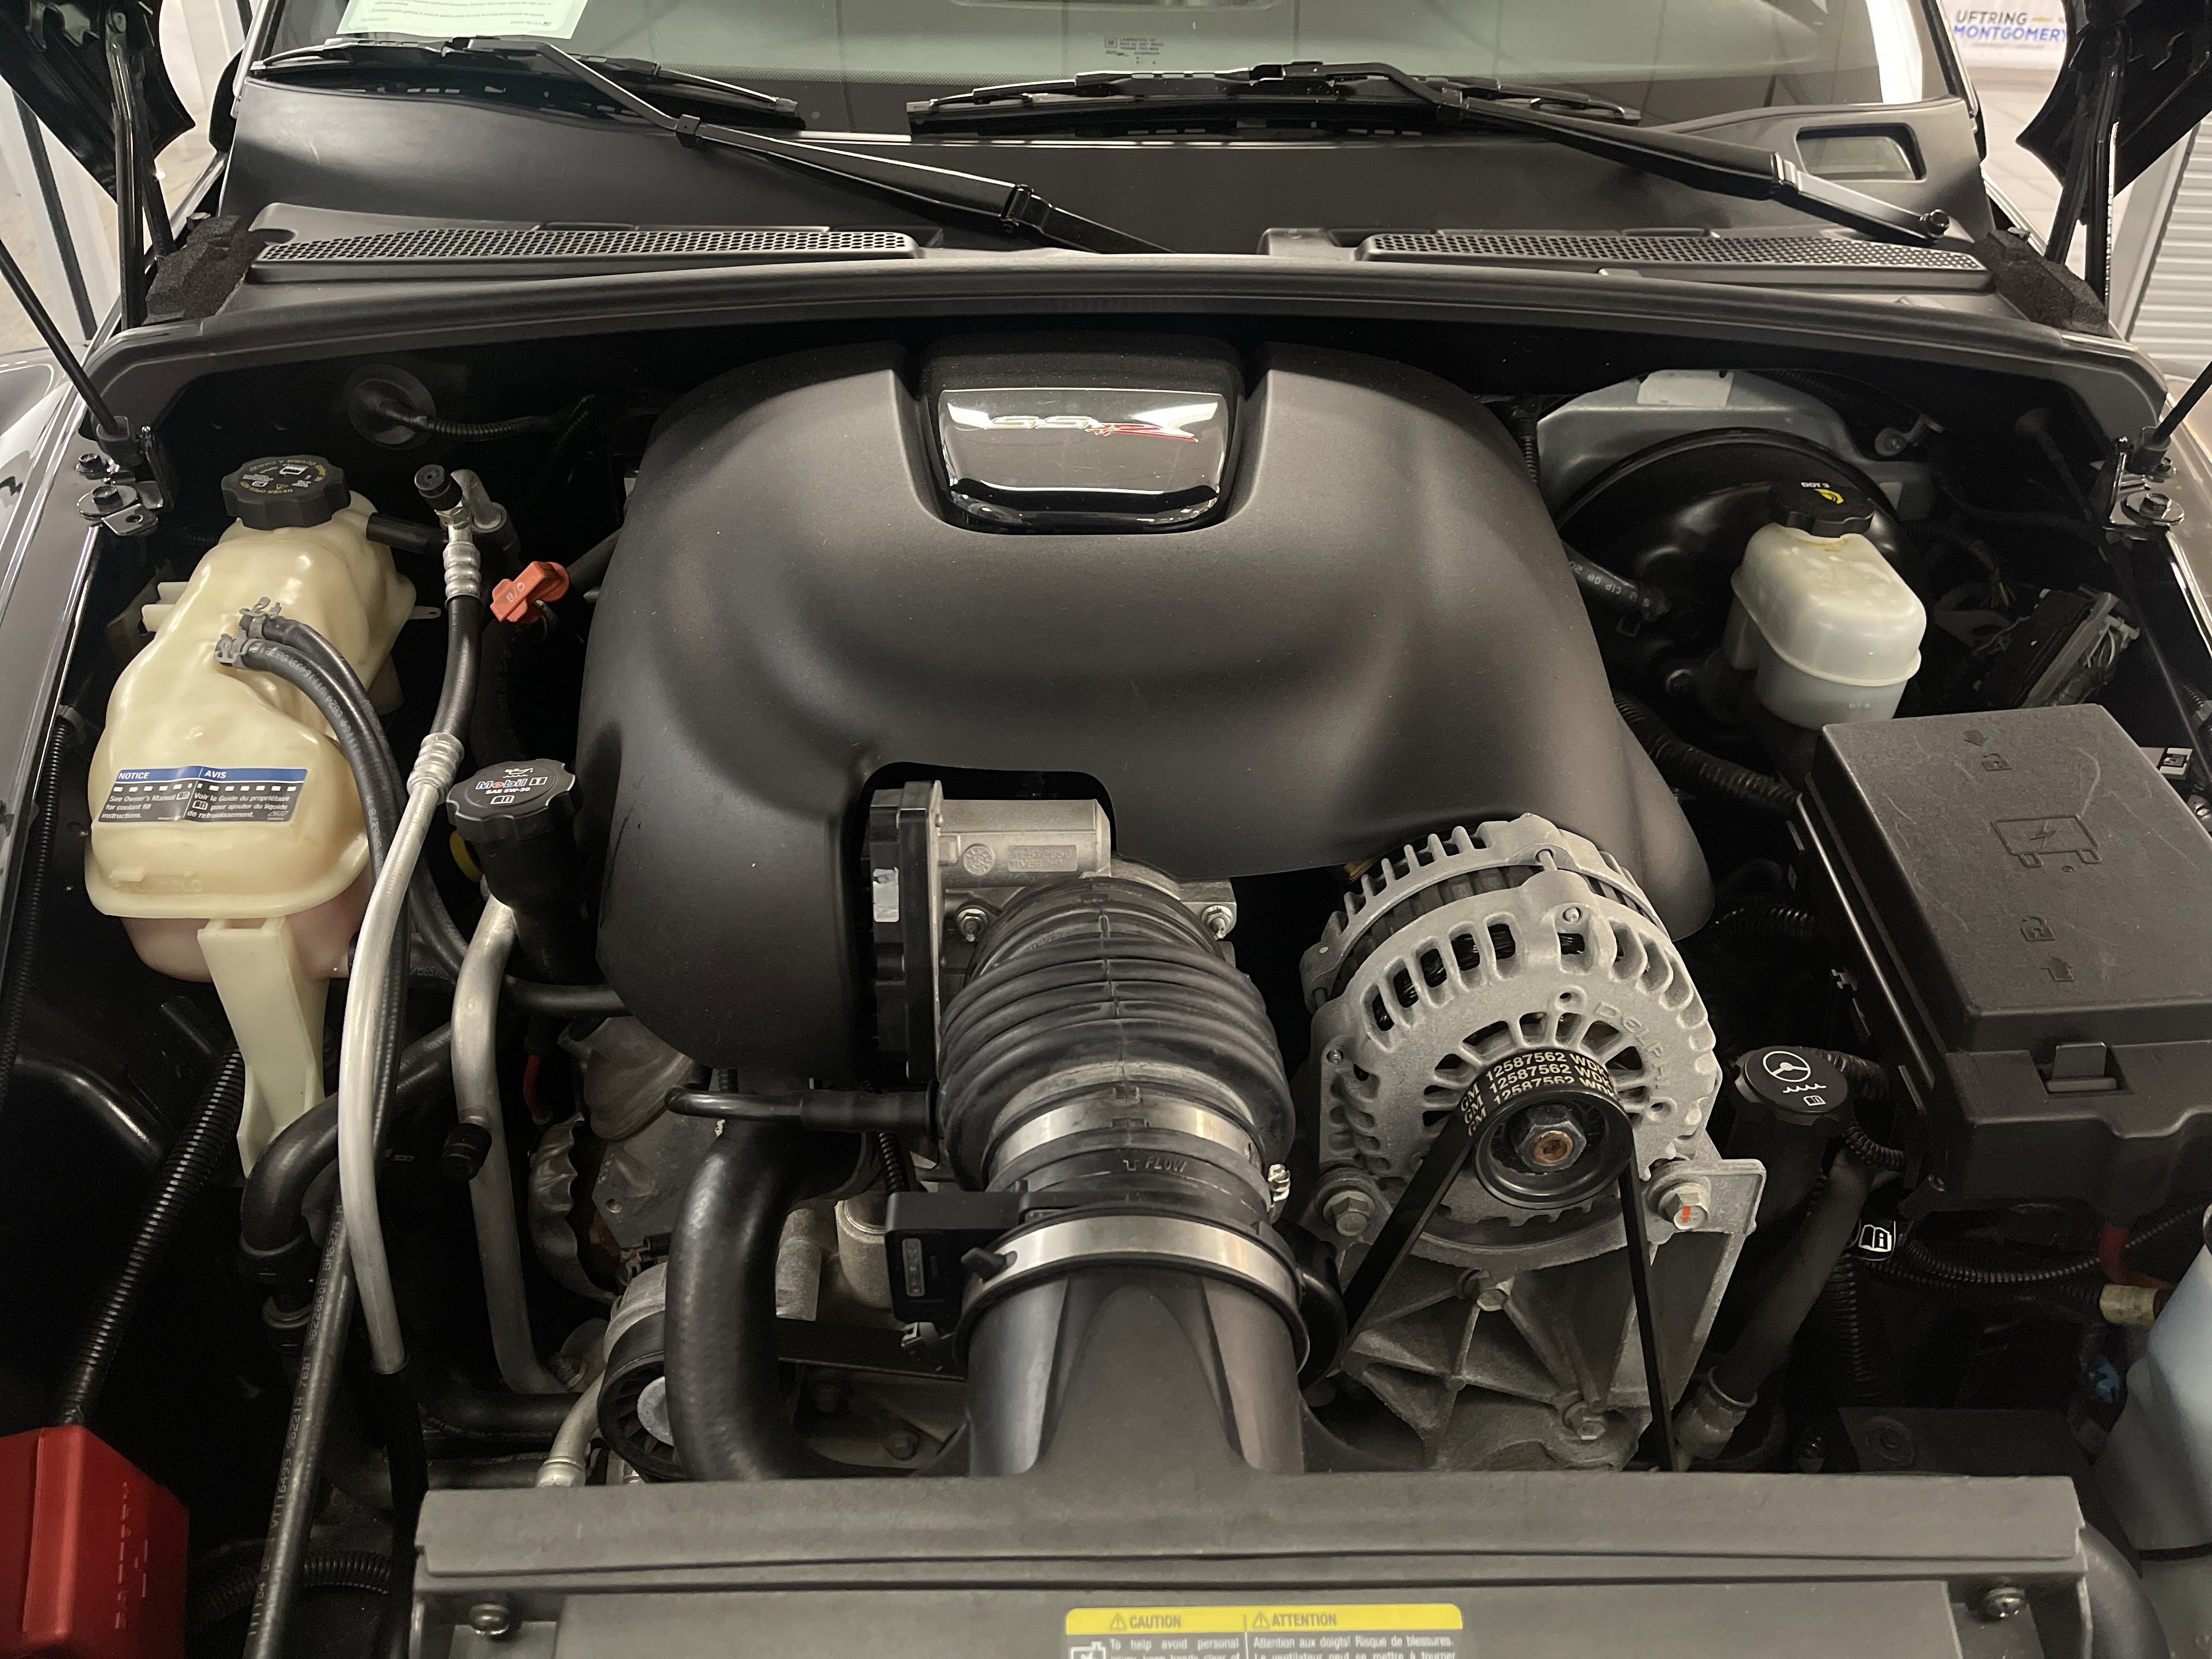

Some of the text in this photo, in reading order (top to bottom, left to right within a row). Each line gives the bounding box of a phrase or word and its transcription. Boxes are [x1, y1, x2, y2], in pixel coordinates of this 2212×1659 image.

[1956, 10, 2027, 24] UFTRING
[205, 770, 227, 779] AVIS
[476, 778, 528, 790] Mobil
[194, 792, 209, 800] Voir
[1460, 1082, 1480, 1112] GM
[1486, 1051, 1567, 1081] 12587562
[1464, 1096, 1483, 1124] GM
[1489, 1064, 1571, 1094] 12587562
[1145, 1156, 1187, 1173] FLOW
[1130, 1615, 1181, 1628] CAUTION
[1272, 1613, 1337, 1627] ATTENTION
[1109, 1637, 1239, 1652] To help avoid personal
[1254, 1634, 1454, 1650] Attention aux doigts! Risque de blessures.
